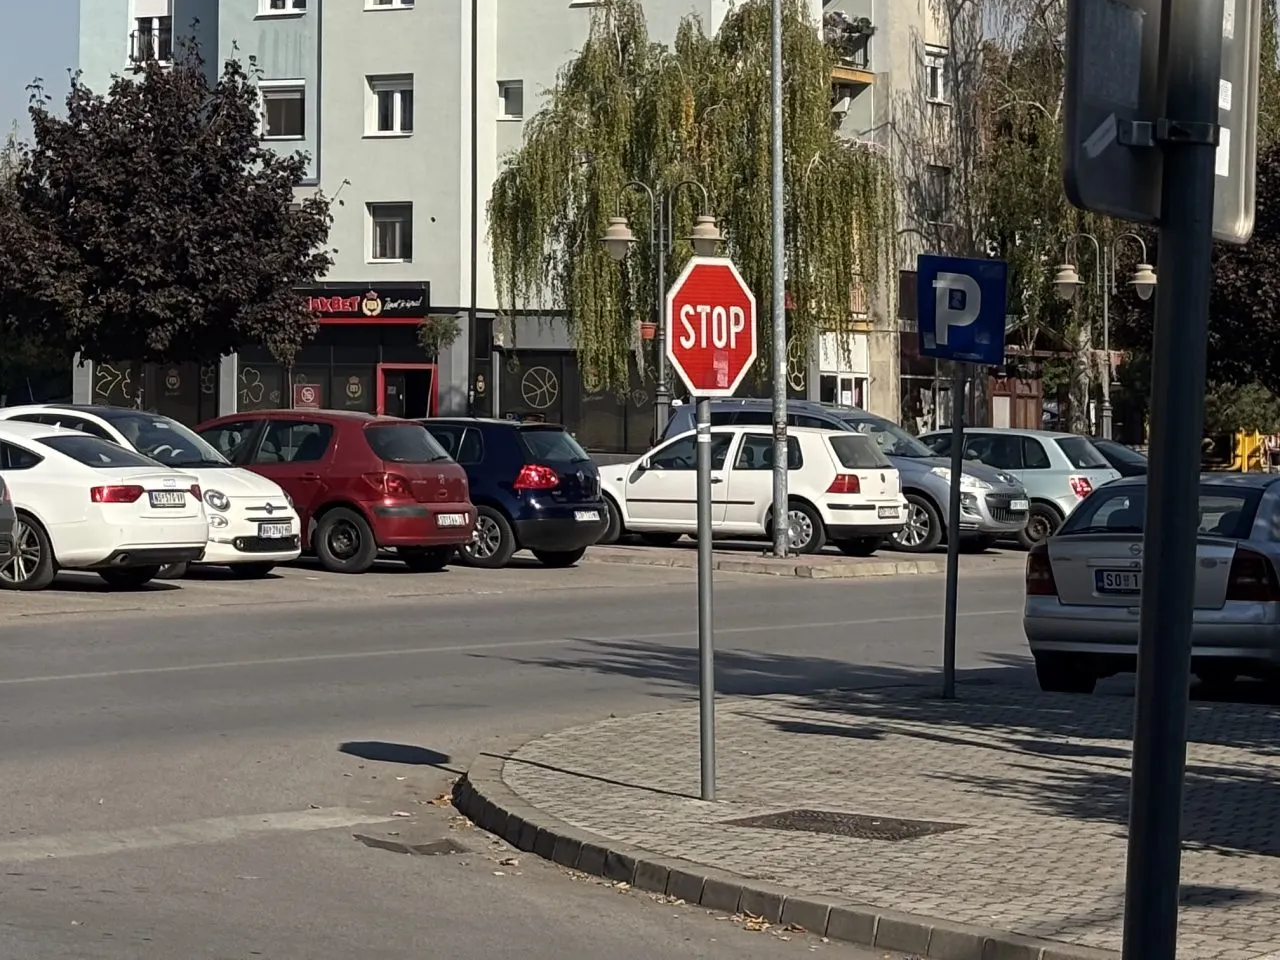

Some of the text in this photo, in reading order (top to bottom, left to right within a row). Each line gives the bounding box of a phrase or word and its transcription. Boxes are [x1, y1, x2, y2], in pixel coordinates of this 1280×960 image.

[679, 303, 745, 350] STOP
[935, 272, 982, 345] P
[1106, 573, 1122, 587] SO
